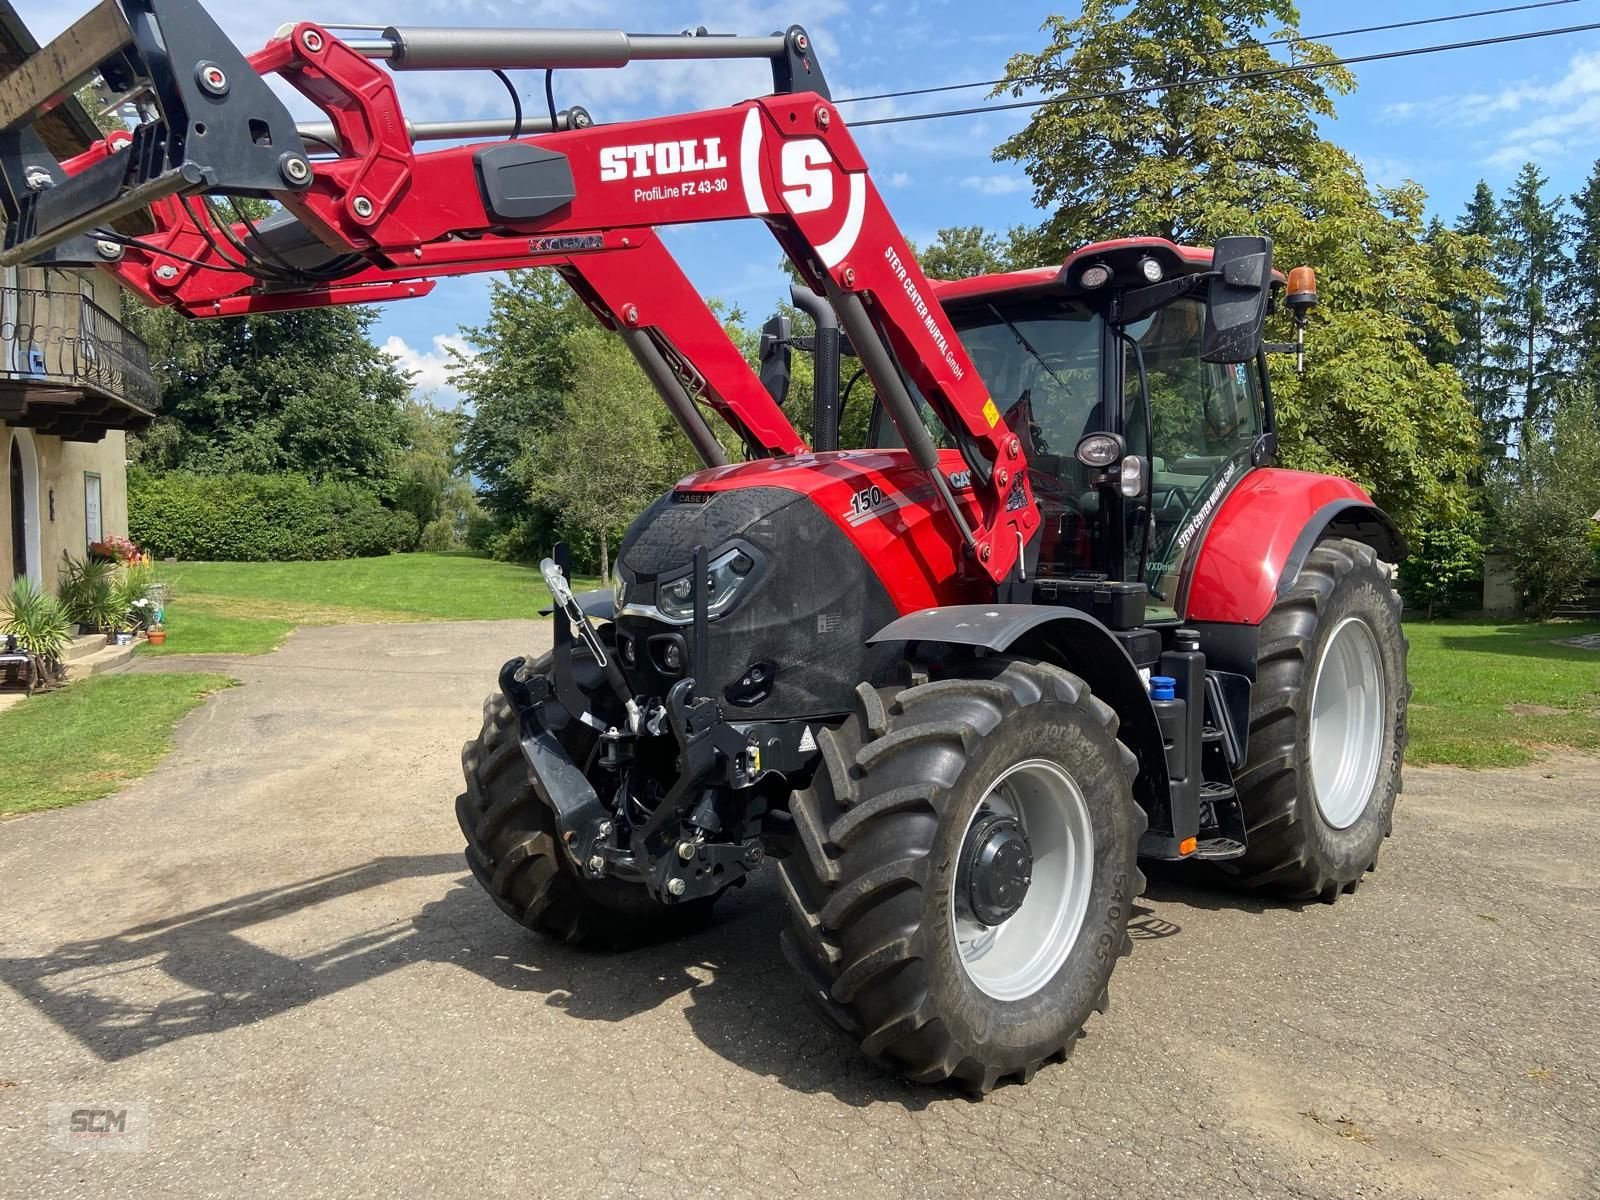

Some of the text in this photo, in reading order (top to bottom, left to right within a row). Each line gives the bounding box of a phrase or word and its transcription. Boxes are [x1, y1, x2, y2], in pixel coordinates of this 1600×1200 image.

[600, 137, 727, 182] STOLL
[634, 178, 728, 202] ProfiLine FZ 43-30
[885, 246, 964, 381] STEYR CENTER MURTAL GmbH
[679, 494, 701, 503] CASE
[850, 485, 882, 515] 150
[1178, 523, 1195, 548] STEYR
[1193, 500, 1212, 528] CENTER
[1209, 478, 1227, 506] MURTAL
[1145, 562, 1176, 571] VXDrive
[1095, 872, 1127, 963] 540/65
